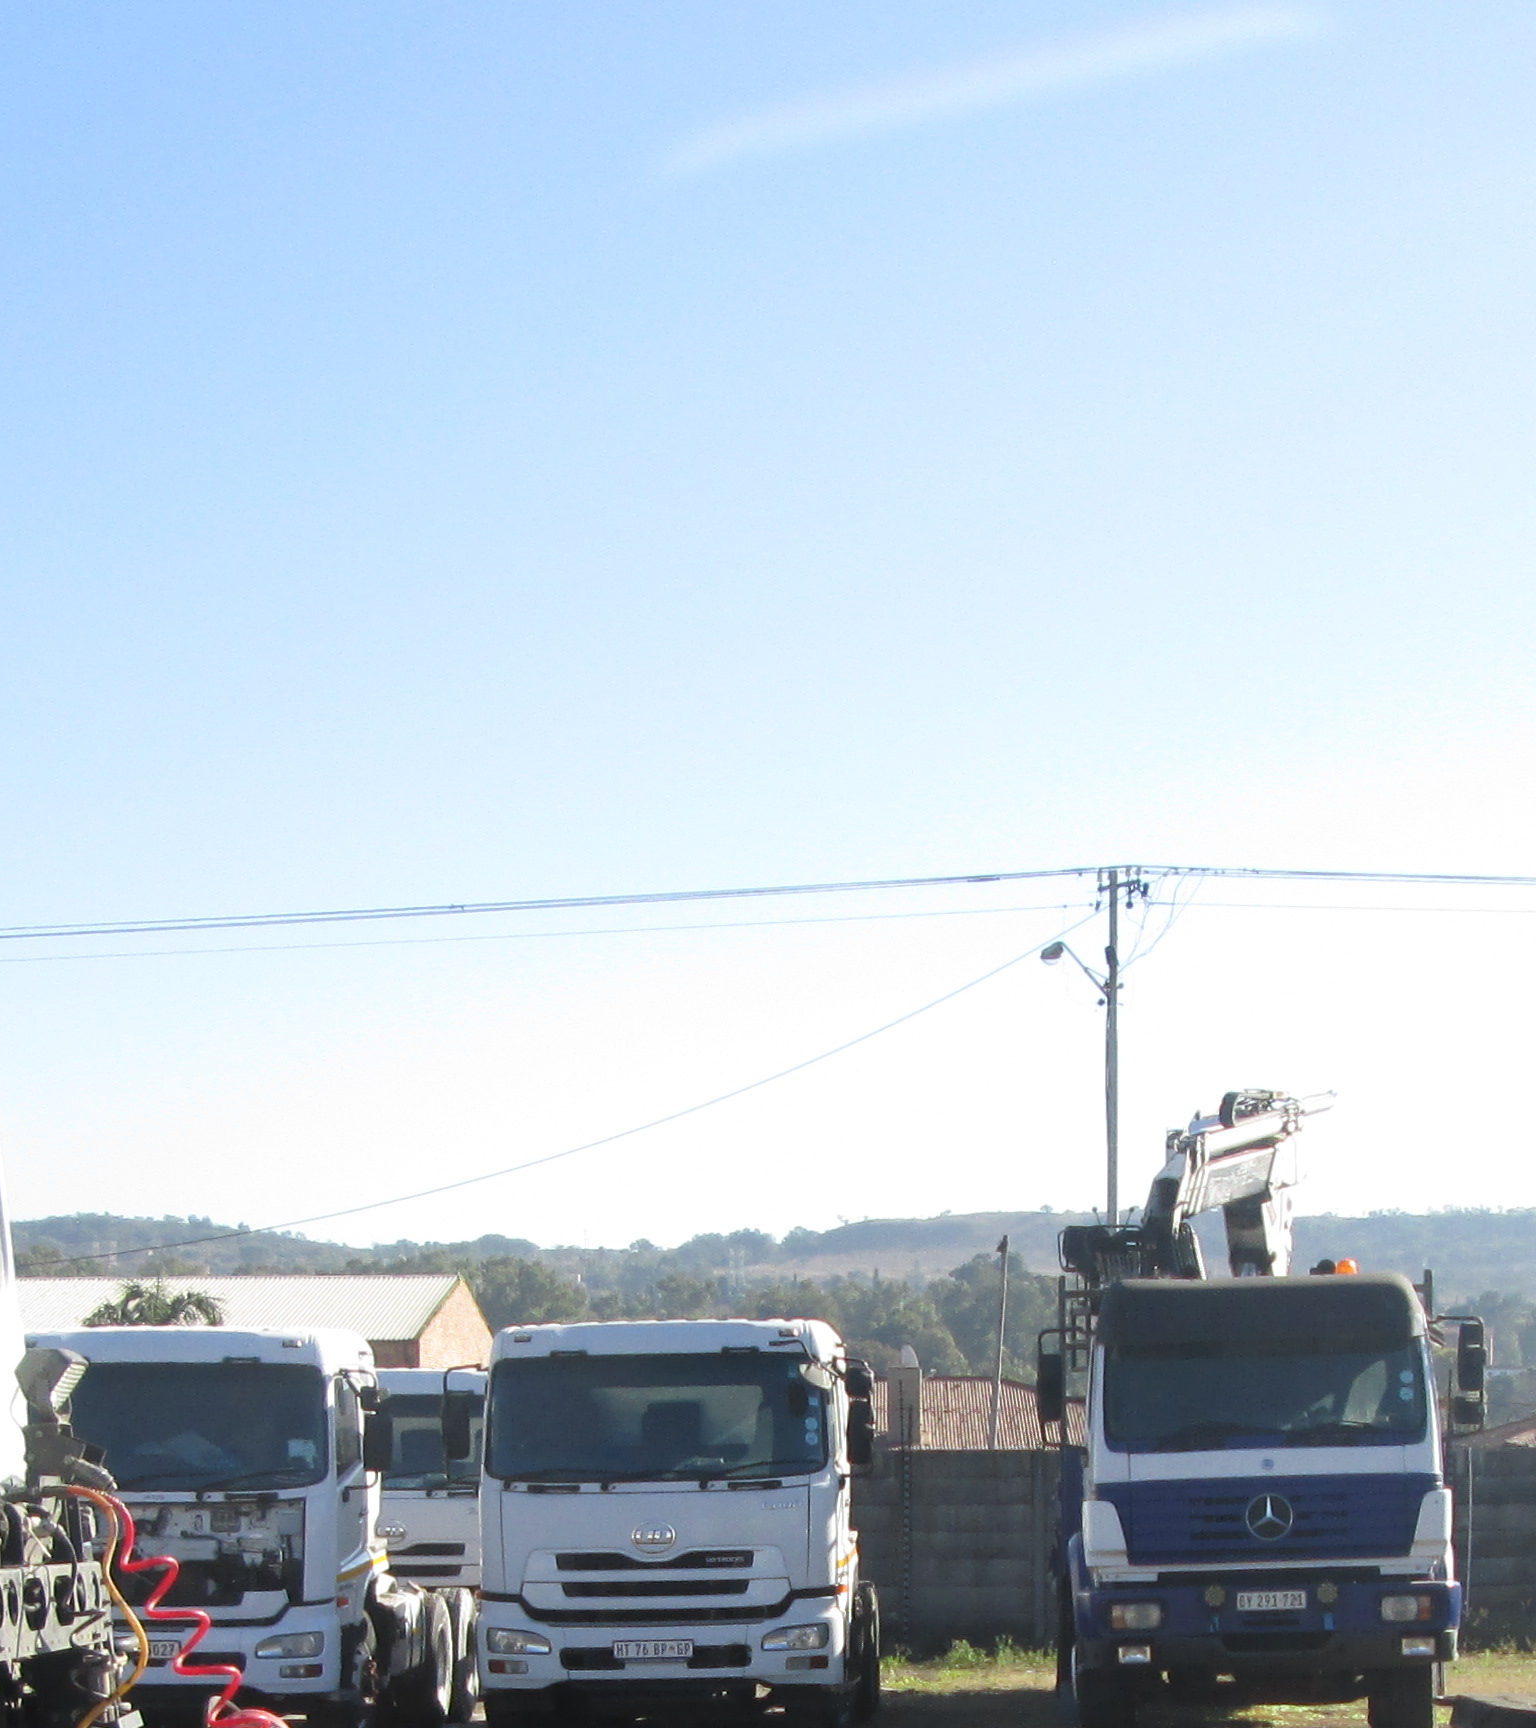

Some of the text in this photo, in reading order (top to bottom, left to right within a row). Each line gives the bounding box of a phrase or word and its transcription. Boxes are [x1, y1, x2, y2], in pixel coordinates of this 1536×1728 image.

[616, 1643, 629, 1657] HT
[636, 1643, 649, 1656] 76
[677, 1642, 691, 1655] GP
